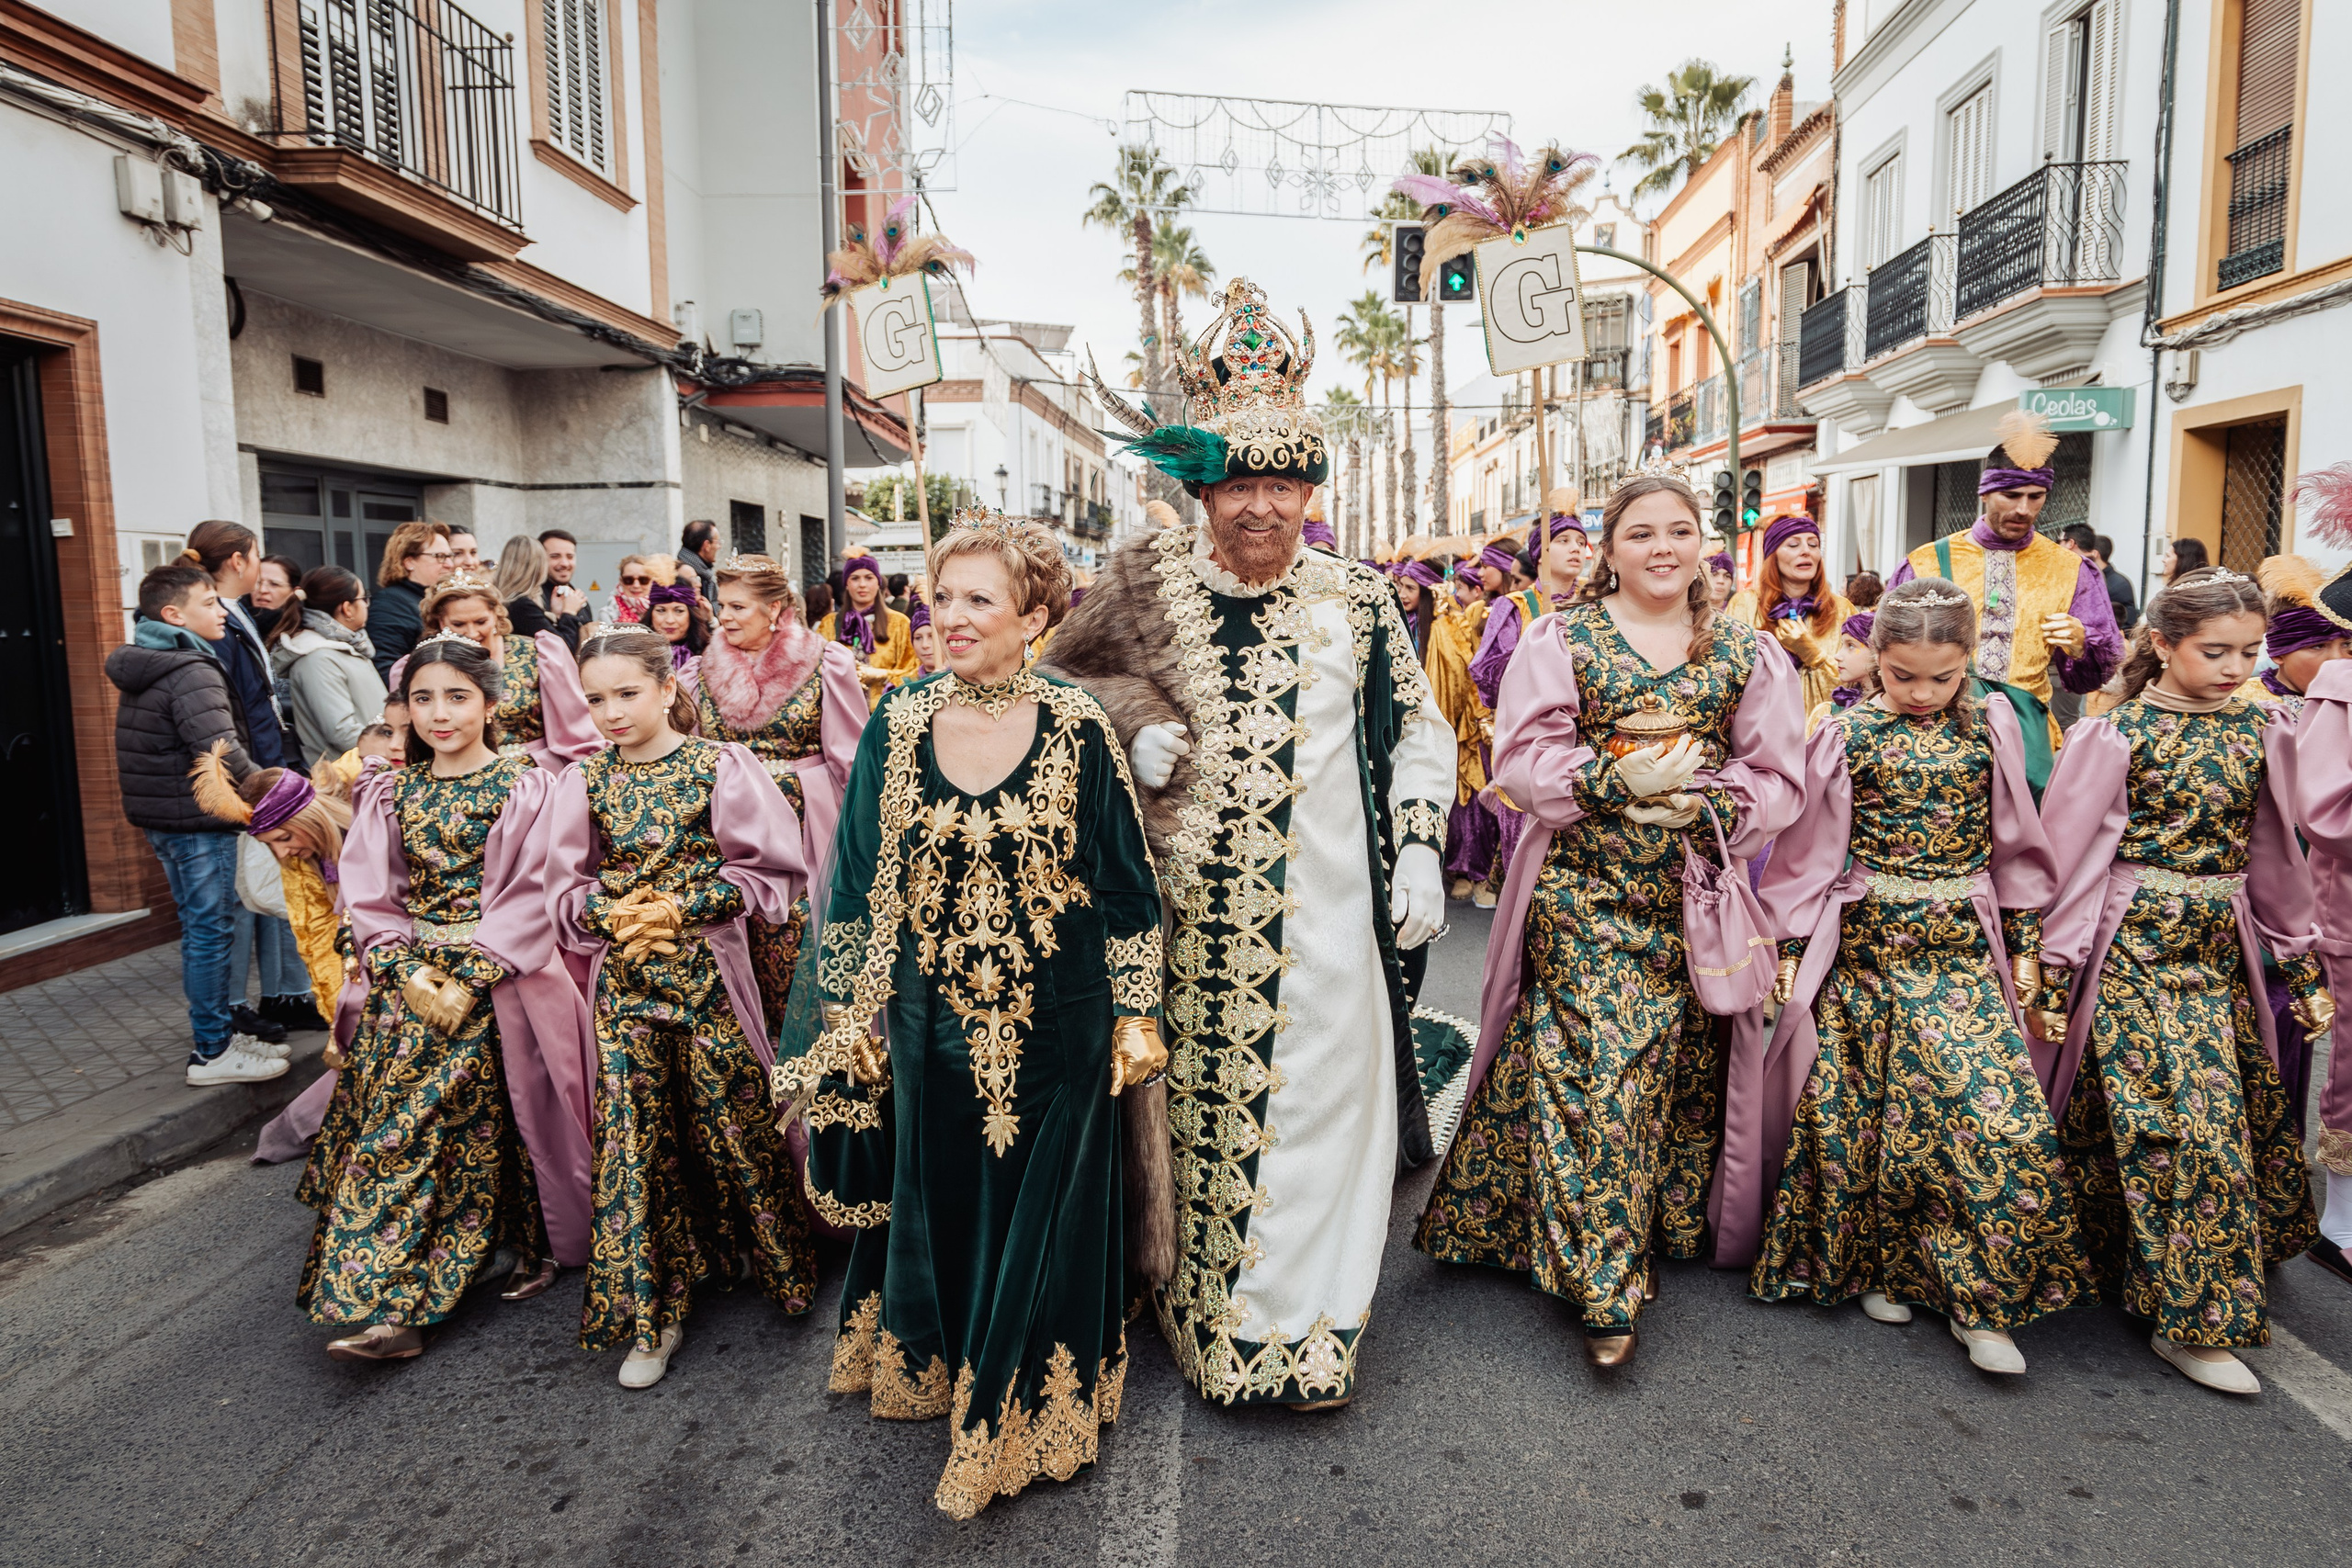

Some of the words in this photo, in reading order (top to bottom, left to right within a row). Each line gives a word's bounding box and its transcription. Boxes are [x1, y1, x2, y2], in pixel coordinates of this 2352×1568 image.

[1489, 253, 1575, 344] G
[864, 294, 927, 372] G
[2030, 391, 2098, 417] Ceolas
[1580, 513, 1604, 528] BV
